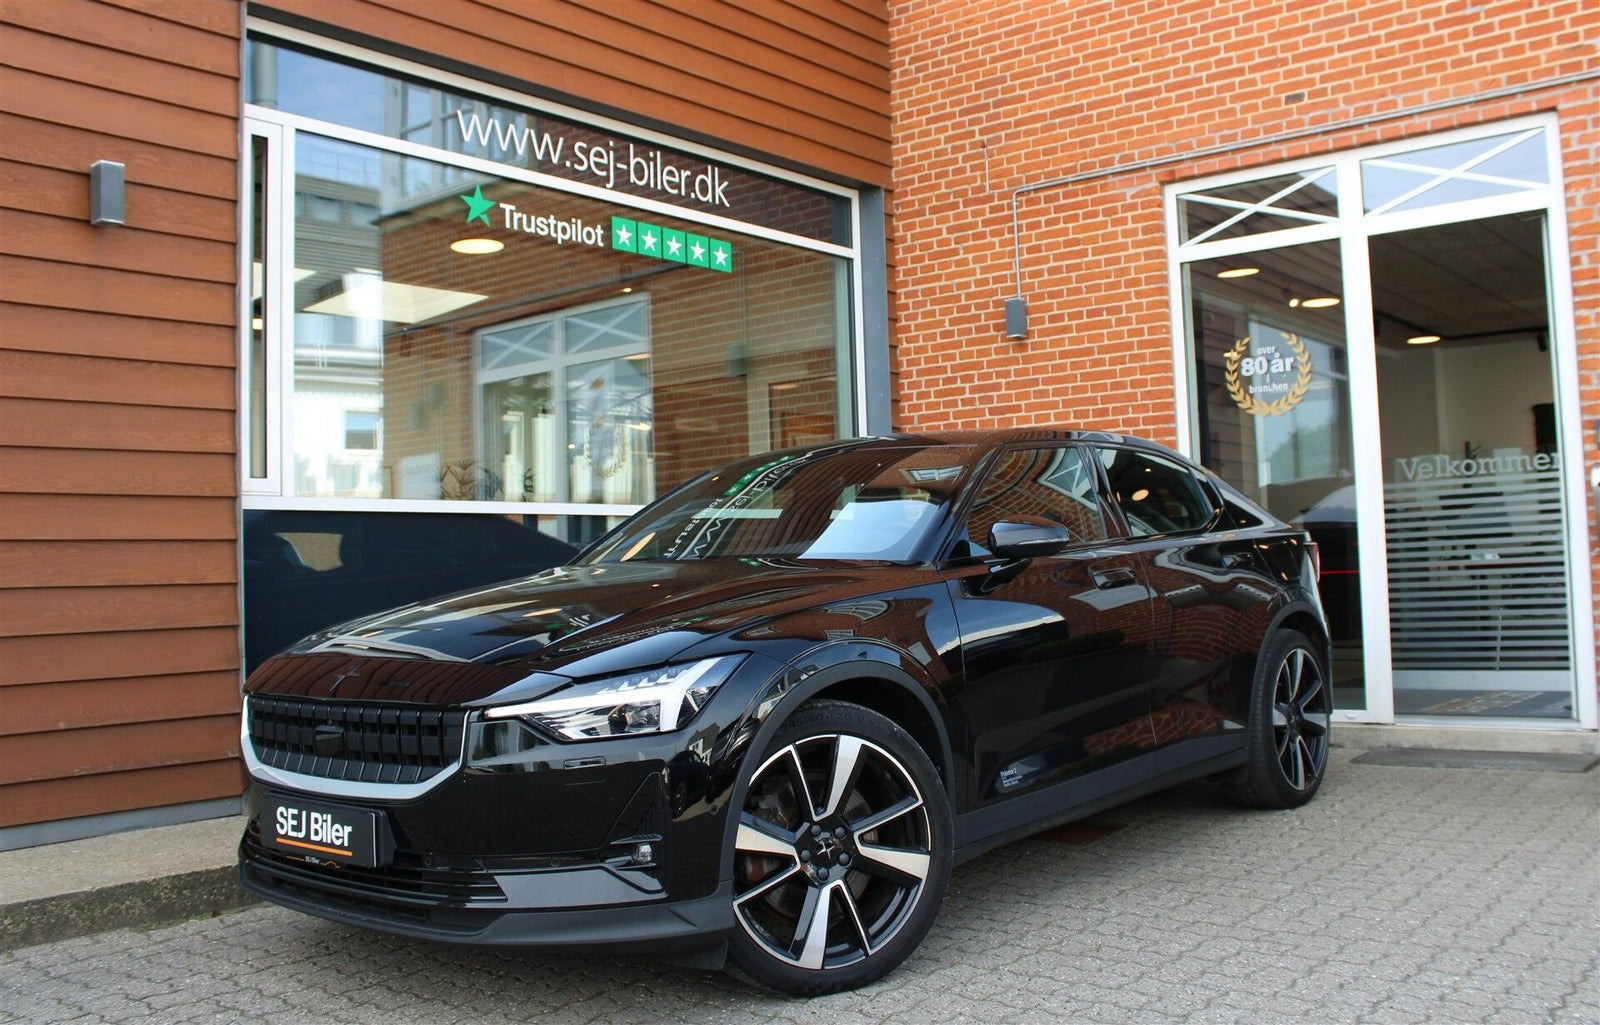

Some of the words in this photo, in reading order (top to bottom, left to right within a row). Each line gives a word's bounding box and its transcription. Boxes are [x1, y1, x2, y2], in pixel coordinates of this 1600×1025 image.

[457, 109, 730, 207] www.sej-biler.dk
[500, 202, 604, 247] Trustpilot
[1241, 356, 1268, 377] 80
[1270, 352, 1295, 373] år
[1257, 346, 1276, 355] over
[276, 806, 306, 838] SEJ
[310, 812, 353, 846] Biler
